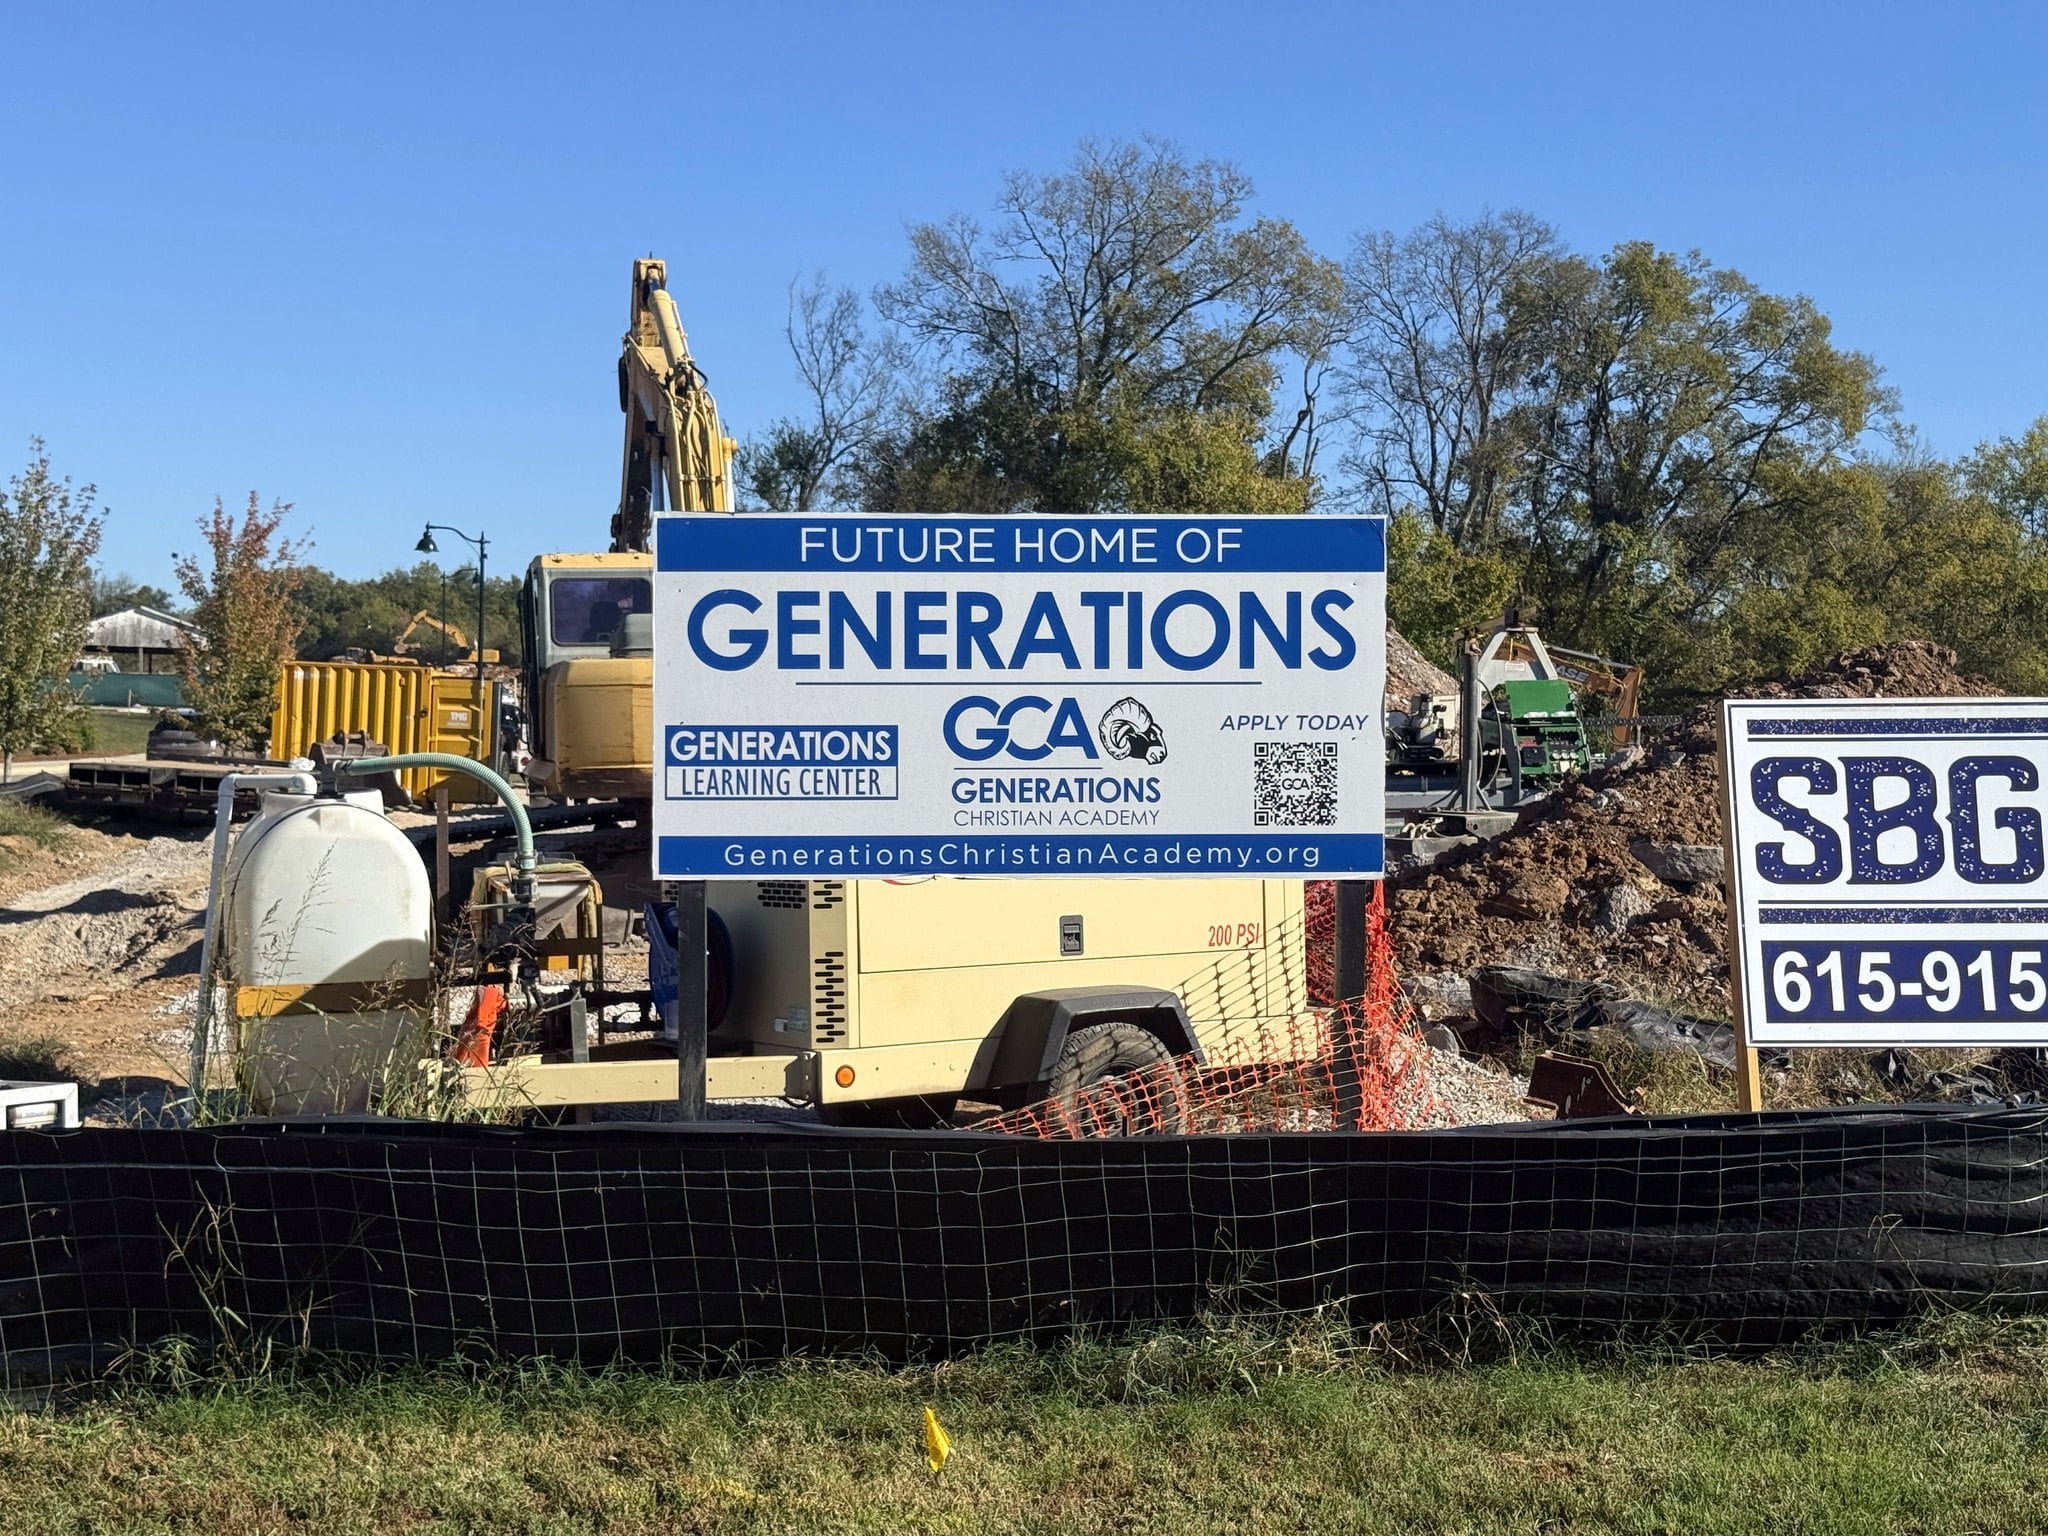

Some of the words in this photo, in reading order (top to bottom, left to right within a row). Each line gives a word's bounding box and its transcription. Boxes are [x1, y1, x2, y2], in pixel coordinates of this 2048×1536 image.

[801, 527, 995, 563] FUTURE
[1015, 527, 1158, 563] HOME
[1176, 527, 1243, 563] OF
[686, 588, 1357, 672] GENERATIONS
[942, 695, 1099, 762] GCA
[1219, 714, 1289, 731] APPLY
[1295, 714, 1369, 731] TODAY
[670, 730, 892, 761] GENERATIONS
[682, 769, 791, 796] LEARNING
[799, 769, 881, 796] CENTER
[951, 776, 1161, 804] GENERATIONS
[1281, 778, 1310, 791] GCA
[953, 809, 1052, 827] CHRISTIAN
[1058, 809, 1160, 827] ACADEMY
[1750, 755, 2045, 885] SBG
[724, 842, 1319, 868] GenerationsChristianAcademy.org
[1208, 924, 1233, 947] 200
[1236, 922, 1260, 945] PSI
[1772, 950, 2047, 1013] 615-915
